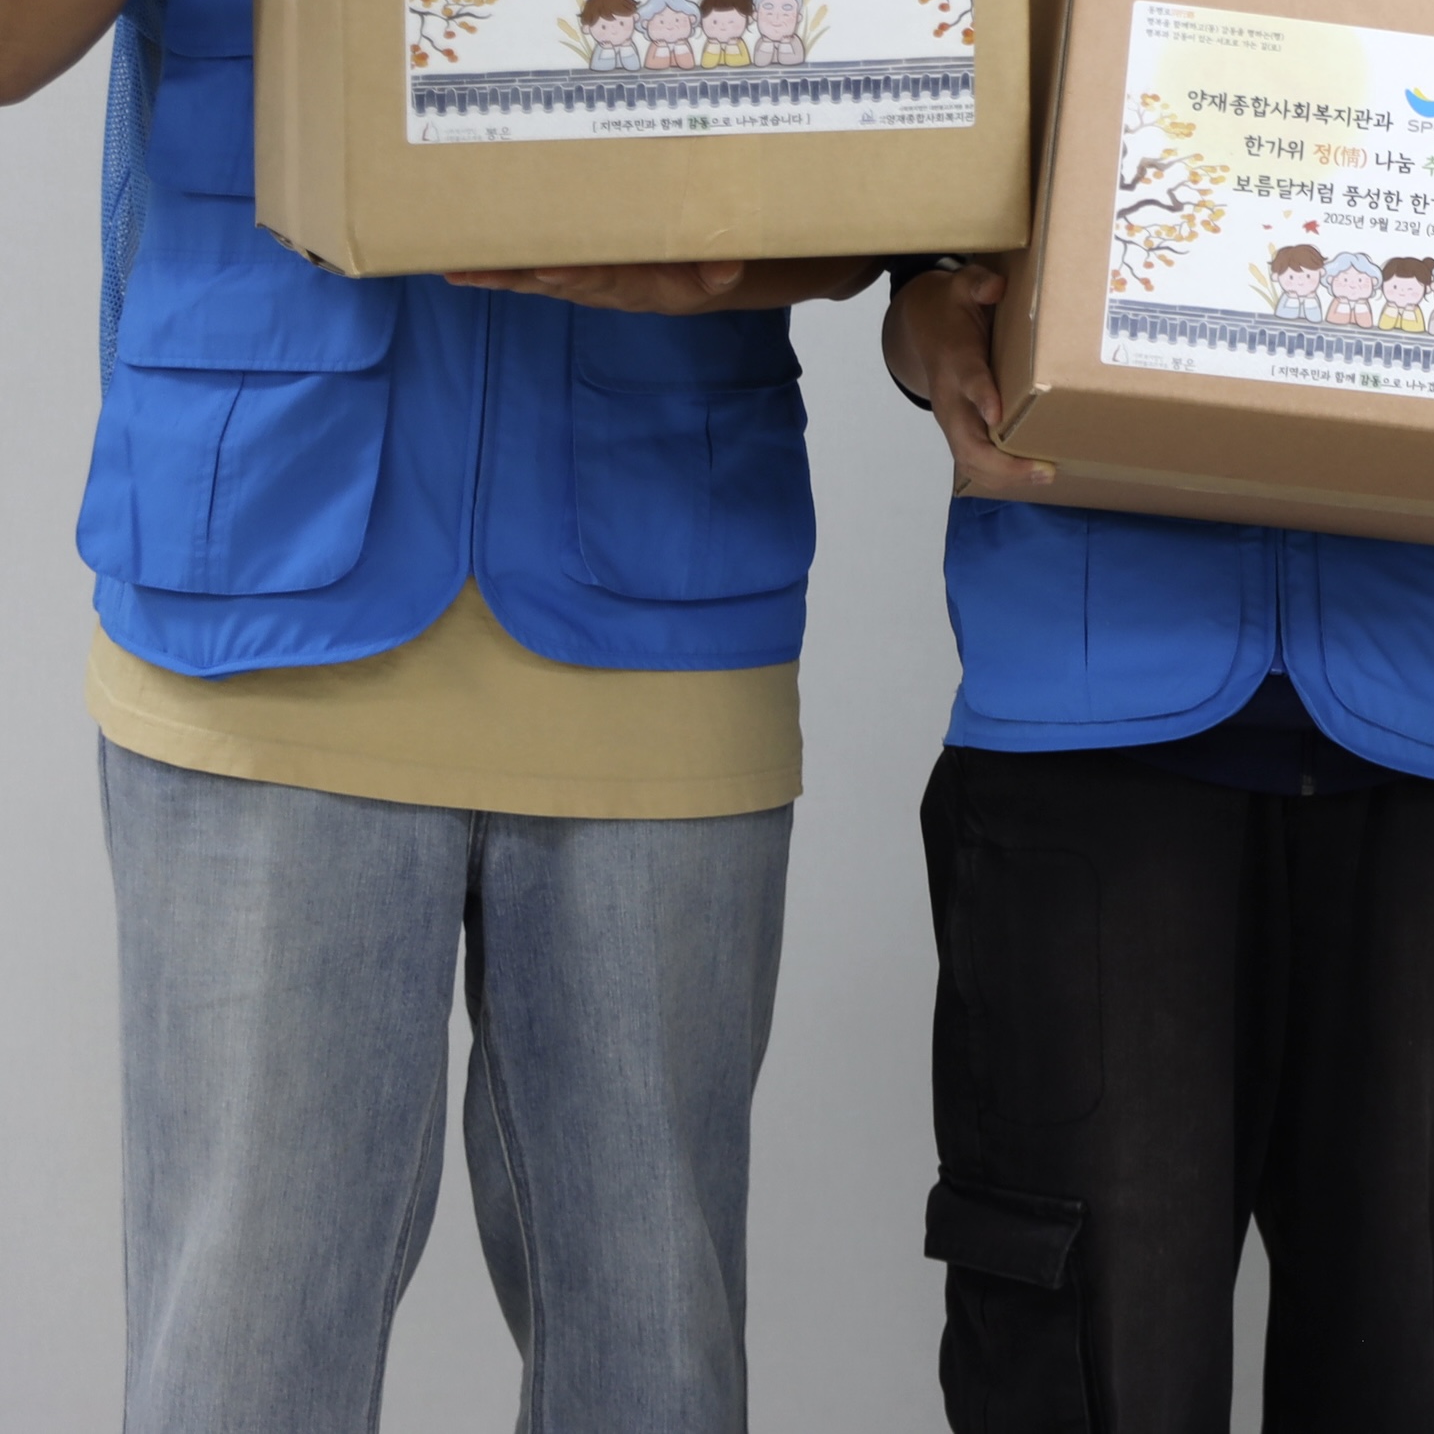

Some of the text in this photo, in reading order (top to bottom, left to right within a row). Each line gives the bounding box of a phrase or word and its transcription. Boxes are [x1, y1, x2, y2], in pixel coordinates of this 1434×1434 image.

[1187, 89, 1394, 132] 양재종합사회복지관과
[1244, 135, 1304, 161] 한가위
[1313, 143, 1368, 168] 정(情)
[1375, 150, 1415, 174] 나눔
[1233, 175, 1334, 204] 보름달처럼
[1342, 185, 1403, 212] 풍성한
[1323, 212, 1365, 230] 2025년
[1369, 217, 1389, 232] 9월
[1394, 220, 1421, 236] 23일
